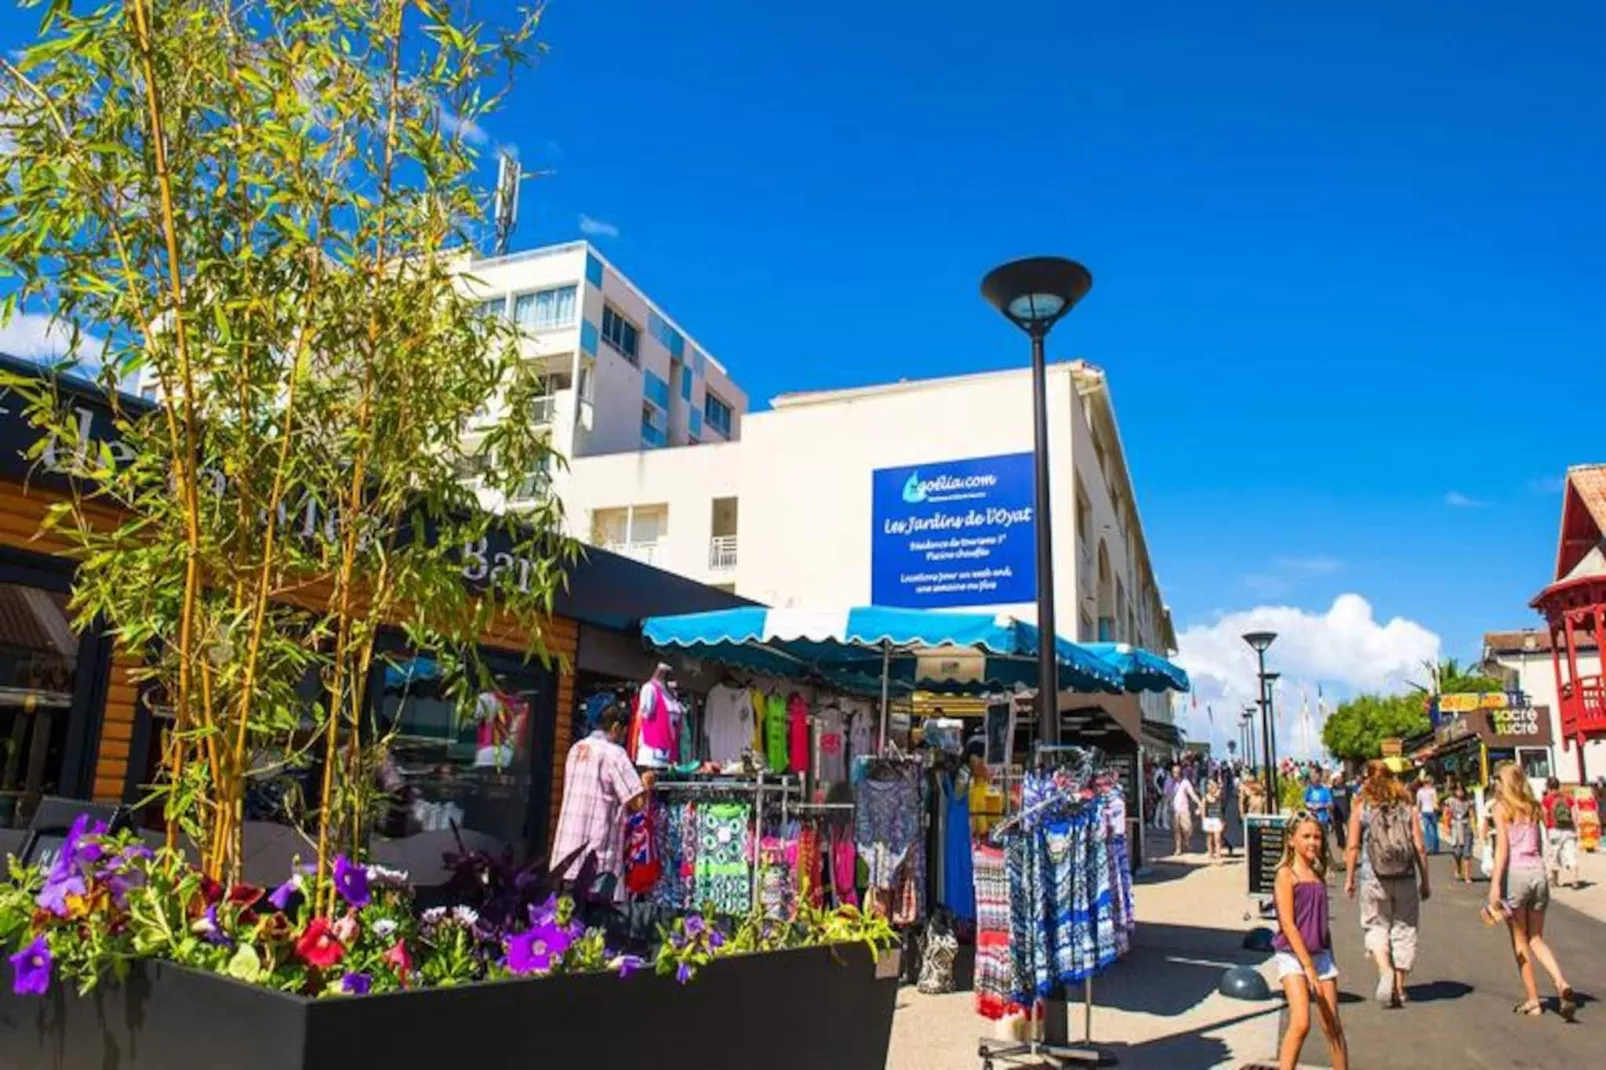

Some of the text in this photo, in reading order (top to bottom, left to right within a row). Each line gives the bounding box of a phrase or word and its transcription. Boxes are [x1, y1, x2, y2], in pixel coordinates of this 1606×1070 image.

[884, 518, 904, 534] Les
[905, 511, 964, 535] Jardins
[964, 509, 986, 526] de
[462, 536, 535, 594] Bar
